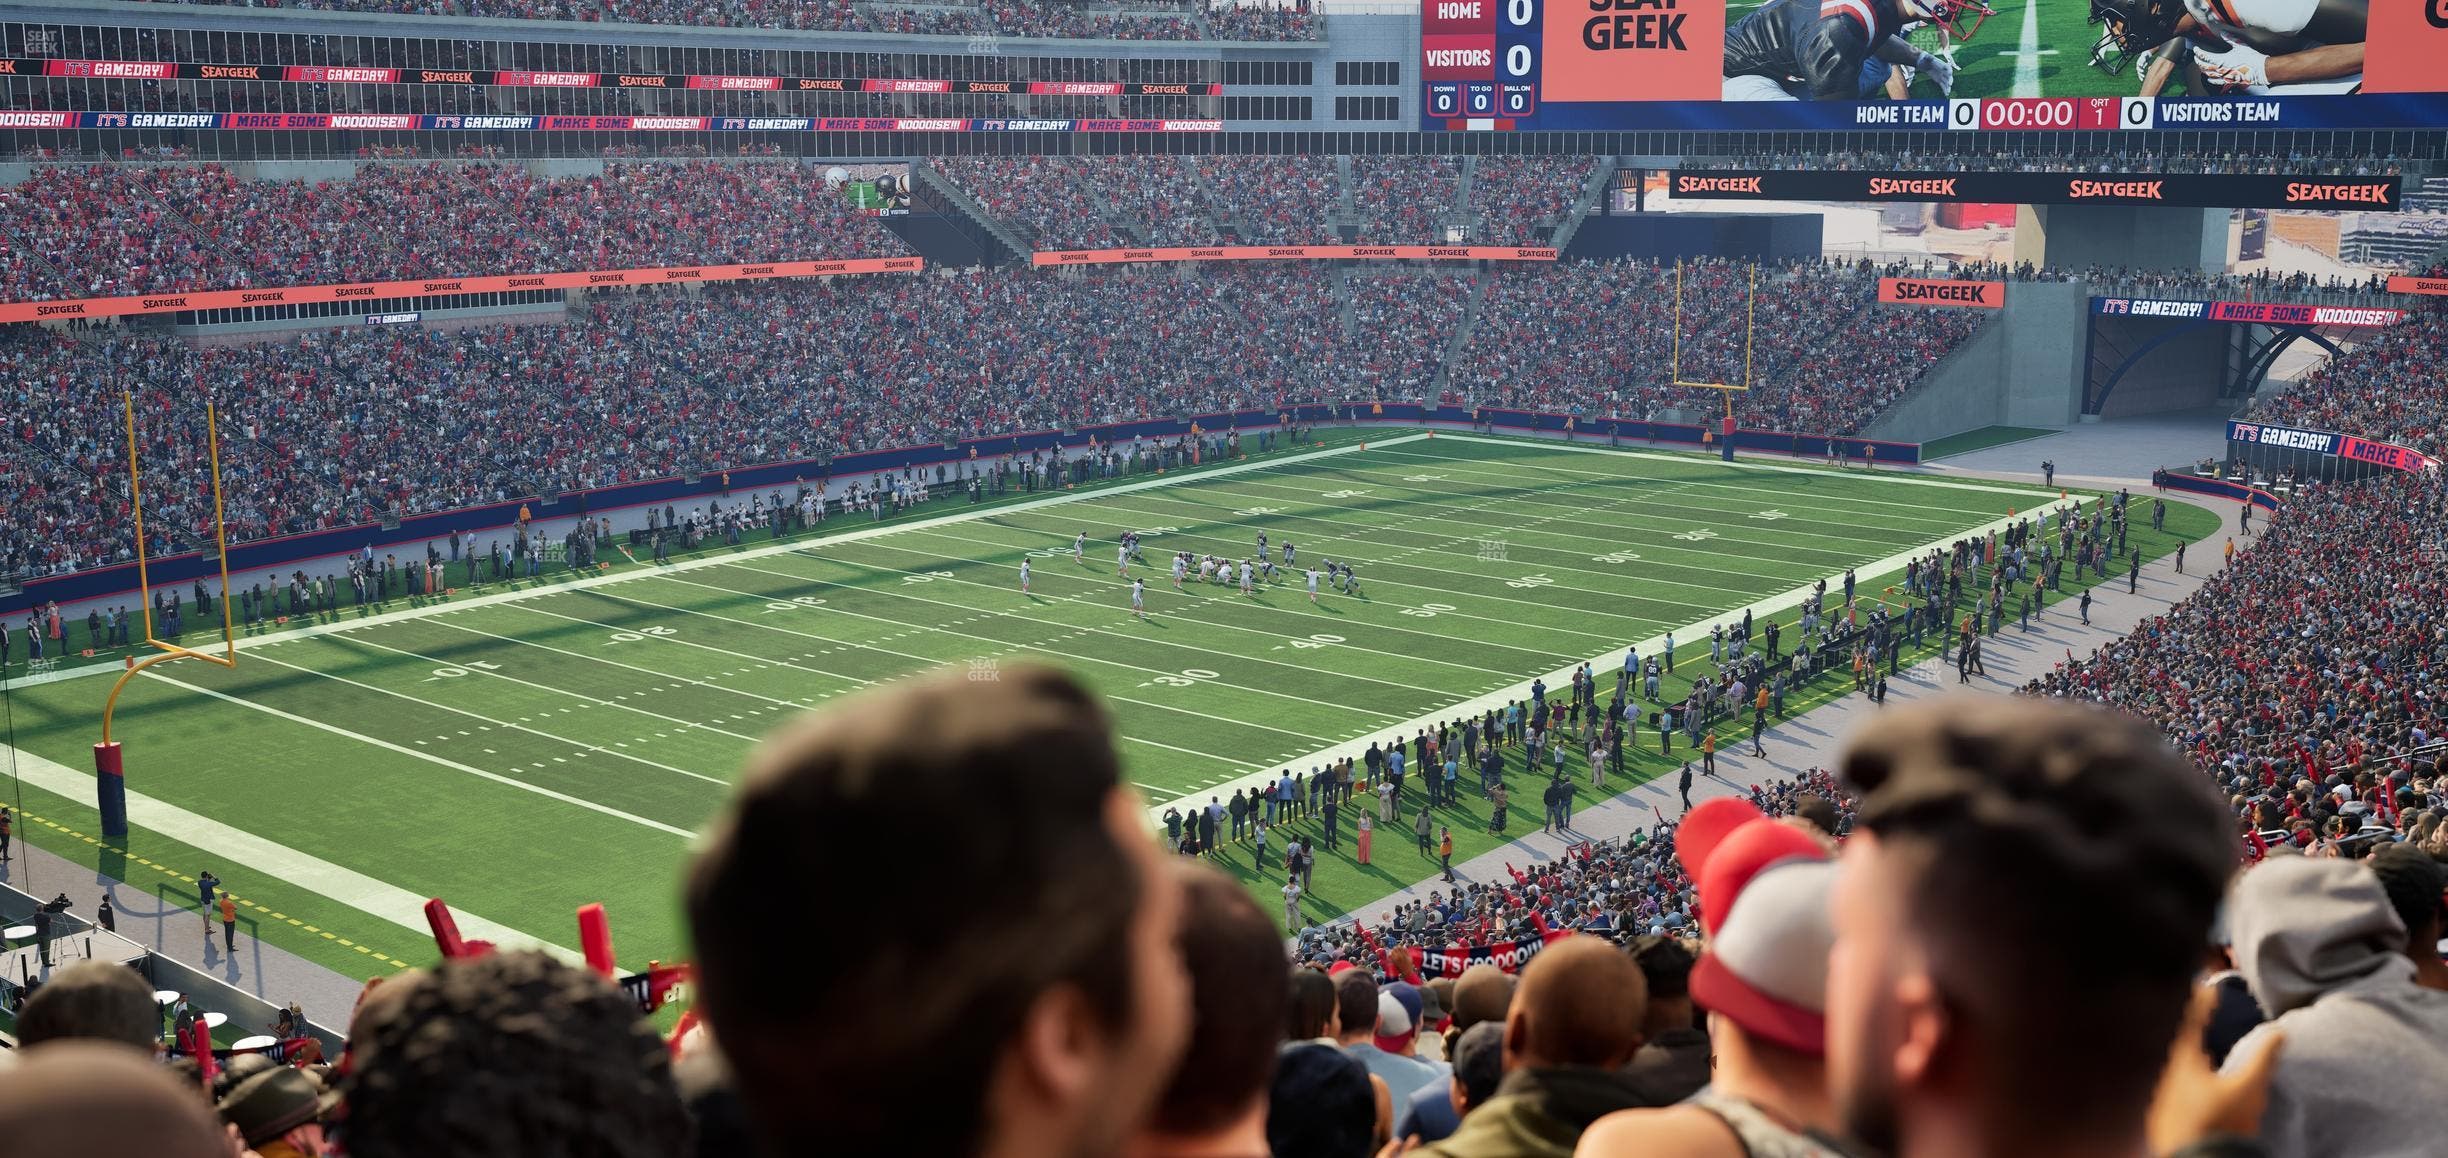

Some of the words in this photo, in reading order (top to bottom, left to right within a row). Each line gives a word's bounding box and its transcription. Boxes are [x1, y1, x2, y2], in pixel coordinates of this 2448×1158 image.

[1438, 2, 1481, 19] HOME
[1508, 0, 1533, 26] 0
[1583, 14, 1688, 51] GEEK
[1426, 49, 1491, 67] VISITORS
[1506, 44, 1532, 76] 0
[94, 64, 164, 77] GAMEDAY!
[200, 66, 259, 79] SEATGEEK
[327, 69, 388, 82] GAMEDAY!
[421, 71, 473, 84] SEATGEEK
[533, 74, 590, 86] GAMEDAY!
[619, 75, 666, 88] SEATGEEK
[721, 78, 773, 89] GAMEDAY!
[799, 79, 843, 90] SEATGEEK
[895, 81, 943, 92] GAMEDAY!
[969, 82, 1010, 93] SEATGEEK
[1065, 84, 1115, 94] GAMEDAY!
[1142, 84, 1188, 94] SEATGEEK
[1438, 94, 1451, 110] 0
[1474, 94, 1487, 110] 0
[1511, 94, 1524, 110] 0
[2091, 98, 2109, 108] QRT
[1856, 106, 1899, 124] HOME
[1903, 106, 1945, 123] TEAM
[1955, 102, 1974, 126] 0
[1986, 101, 2073, 126] 00:00
[2095, 108, 2103, 126] 1
[2128, 101, 2148, 125] 0
[2162, 103, 2232, 122] VISITORS
[2236, 103, 2280, 121] TEAM
[96, 114, 127, 127] IT'S
[131, 114, 213, 127] GAMEDAY!
[236, 116, 281, 127] MAKE
[287, 116, 327, 128] SOME
[435, 117, 461, 128] IT'S
[464, 117, 532, 129] GAMEDAY!
[552, 118, 589, 128] MAKE
[595, 118, 629, 128] SOME
[722, 119, 745, 129] IT'S
[748, 119, 808, 130] GAMEDAY!
[826, 120, 859, 129] MAKE
[864, 120, 894, 129] SOME
[1008, 120, 1070, 130] GAMEDAY!
[1087, 121, 1122, 130] MAKE
[1126, 121, 1160, 130] SOME
[1679, 175, 1762, 194] SEATGEEK
[1869, 178, 1956, 196] SEATGEEK
[2069, 180, 2163, 199] SEATGEEK
[2286, 182, 2389, 204] SEATGEEK
[1061, 253, 1089, 261] SEATGEEK
[1124, 251, 1153, 259] SEATGEEK
[1191, 249, 1224, 257] SEATGEEK
[1353, 248, 1396, 256] SEATGEEK
[1428, 248, 1469, 257] SEATGEEK
[1518, 249, 1556, 258] SEATGEEK
[814, 263, 846, 272] SEATGEEK
[884, 260, 914, 269] SEATGEEK
[667, 269, 701, 279] SEATGEEK
[742, 266, 774, 276] SEATGEEK
[508, 277, 545, 288] SEATGEEK
[590, 273, 625, 283] SEATGEEK
[335, 286, 375, 298] SEATGEEK
[424, 281, 462, 292] SEATGEEK
[1896, 281, 1986, 303] SEATGEEK
[143, 297, 187, 309] SEATGEEK
[242, 292, 284, 303] SEATGEEK
[37, 303, 85, 315] SEATGEEK
[2103, 299, 2129, 313] IT'S
[2131, 300, 2204, 317] GAMEDAY!
[2223, 303, 2266, 320] MAKE
[2271, 307, 2311, 322] SOME
[2233, 423, 2258, 442] IT'S
[2260, 427, 2331, 451] GAMEDAY!
[2352, 441, 2400, 465] MAKE
[1505, 576, 1554, 588] 40
[1398, 603, 1457, 618] 50
[1289, 634, 1347, 649] 40
[1153, 669, 1220, 687] 30
[1422, 951, 1461, 973] LET'S
